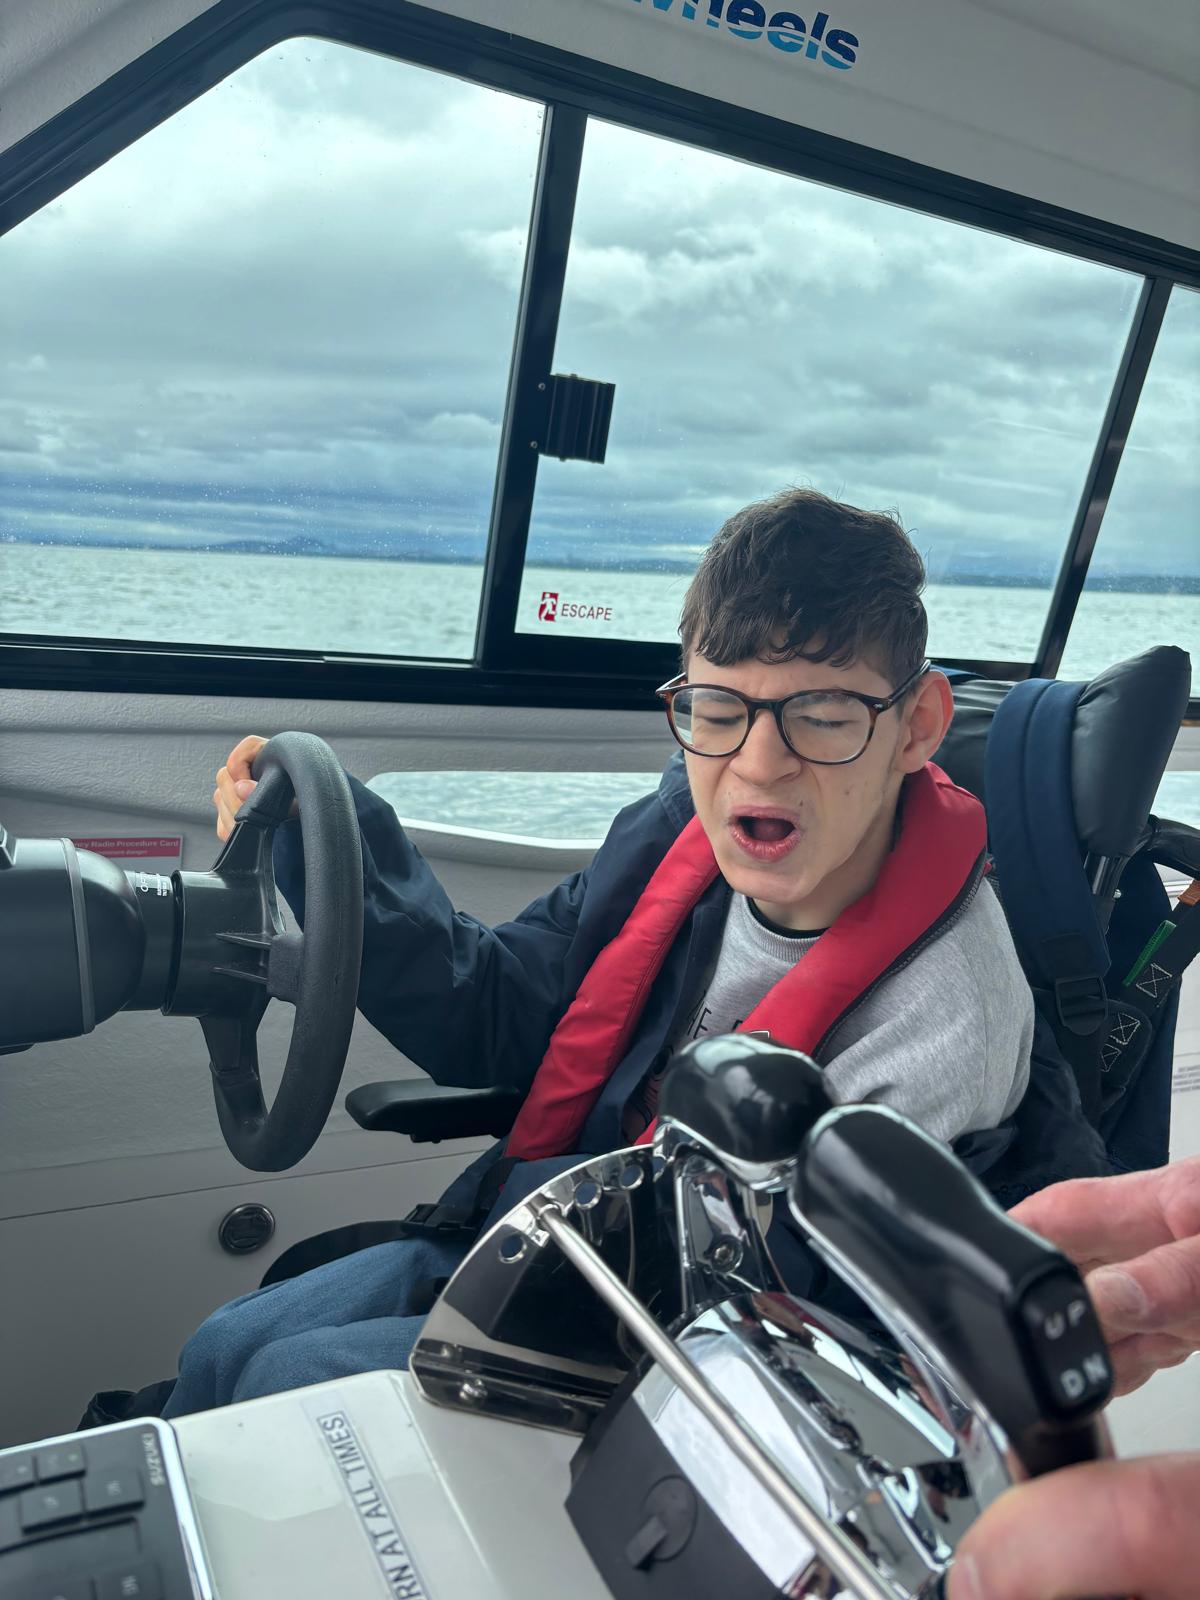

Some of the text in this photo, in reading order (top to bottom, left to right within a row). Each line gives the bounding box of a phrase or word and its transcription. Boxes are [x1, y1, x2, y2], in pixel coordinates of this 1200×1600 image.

[632, 0, 859, 70] eels
[561, 603, 613, 621] ESCAPE
[116, 840, 157, 848] Procedure
[160, 839, 179, 848] Card
[322, 1416, 422, 1600] RN AT ALL TIMES
